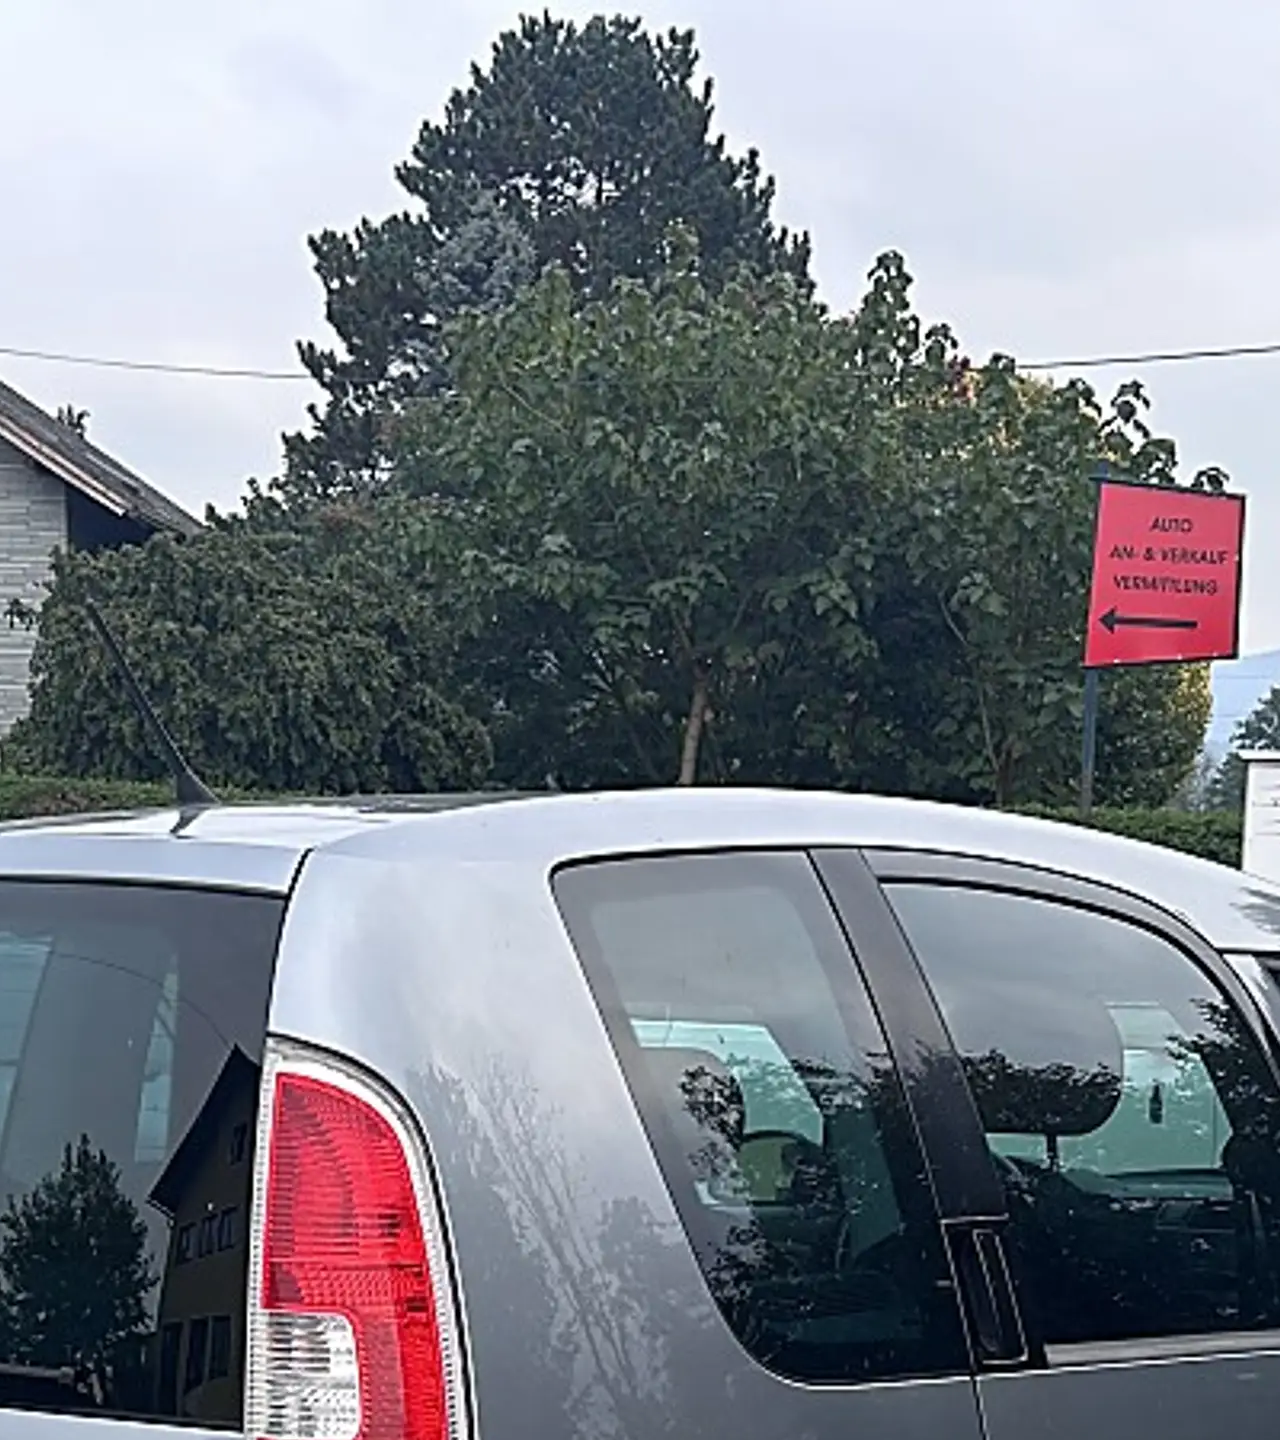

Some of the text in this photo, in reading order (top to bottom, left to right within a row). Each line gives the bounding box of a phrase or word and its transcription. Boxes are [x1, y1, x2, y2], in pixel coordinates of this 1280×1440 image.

[1149, 517, 1193, 533] AUTO
[1143, 547, 1156, 561] &
[1161, 547, 1229, 565] VERKAUF
[1114, 575, 1218, 595] VERMITTLUNG
